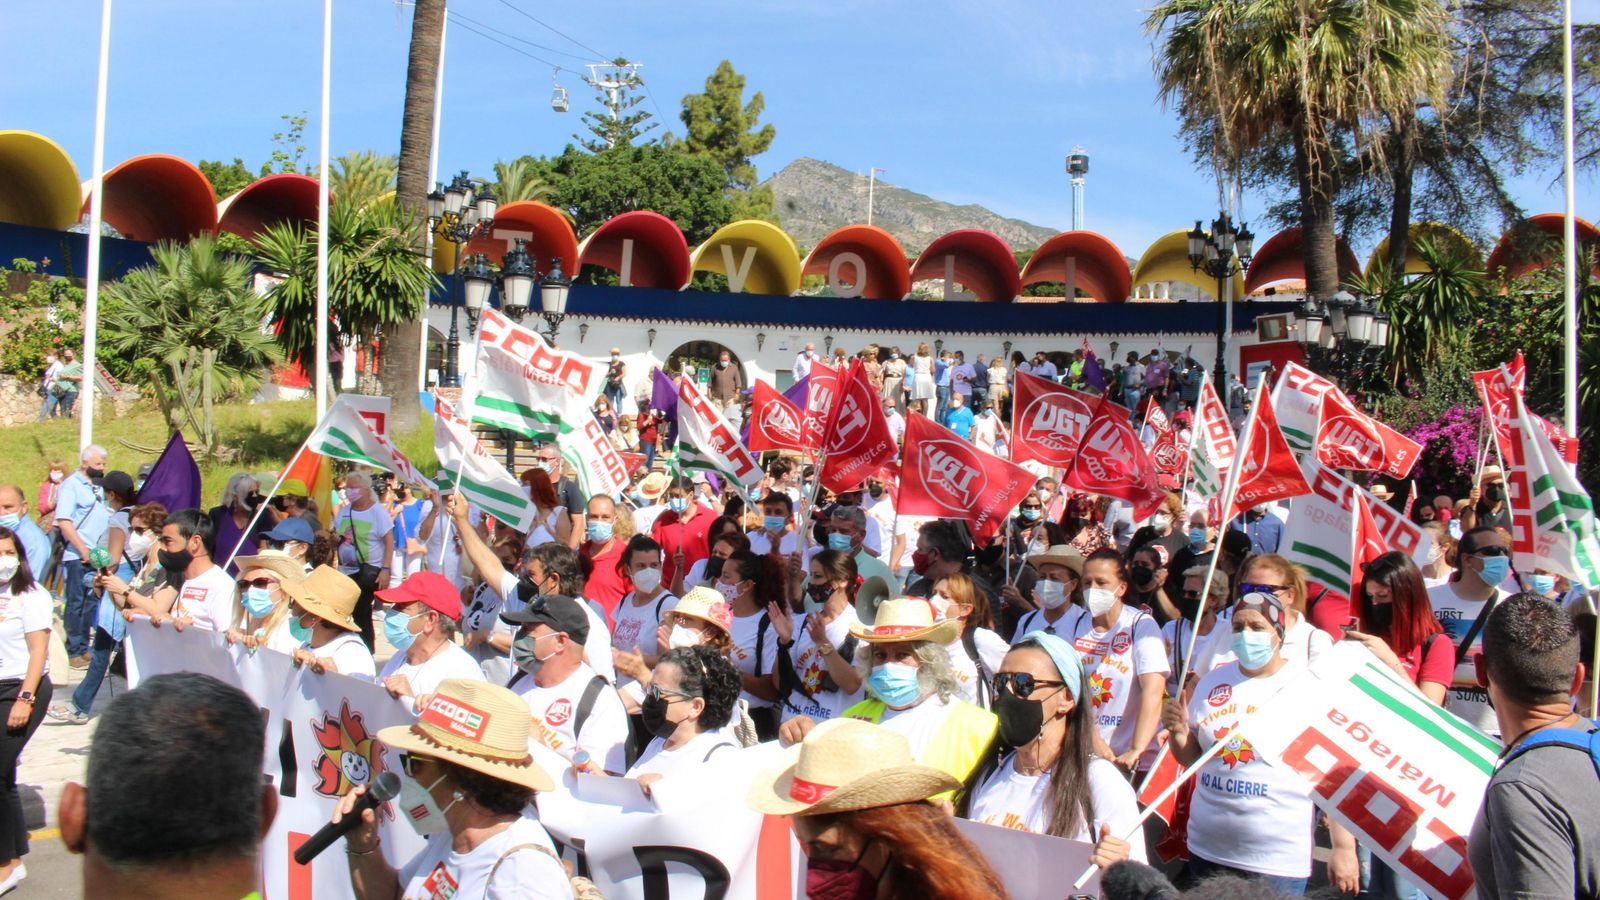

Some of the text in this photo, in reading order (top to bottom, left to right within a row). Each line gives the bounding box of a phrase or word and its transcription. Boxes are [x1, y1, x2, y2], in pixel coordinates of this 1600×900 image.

[480, 310, 593, 396] CCOO
[585, 419, 626, 487] CCOO
[832, 440, 887, 482] www.ugt.es
[1325, 420, 1380, 465] UGT
[925, 444, 980, 493] UGT
[975, 480, 1018, 531] www.ugt.es
[1234, 483, 1287, 504] ugt.es
[428, 698, 470, 724] CCOO
[1200, 704, 1237, 727] Tivoli
[1327, 707, 1456, 809] Málaga
[1211, 776, 1223, 791] AL
[1226, 779, 1268, 797] CIERRE
[1282, 726, 1475, 900] COO
